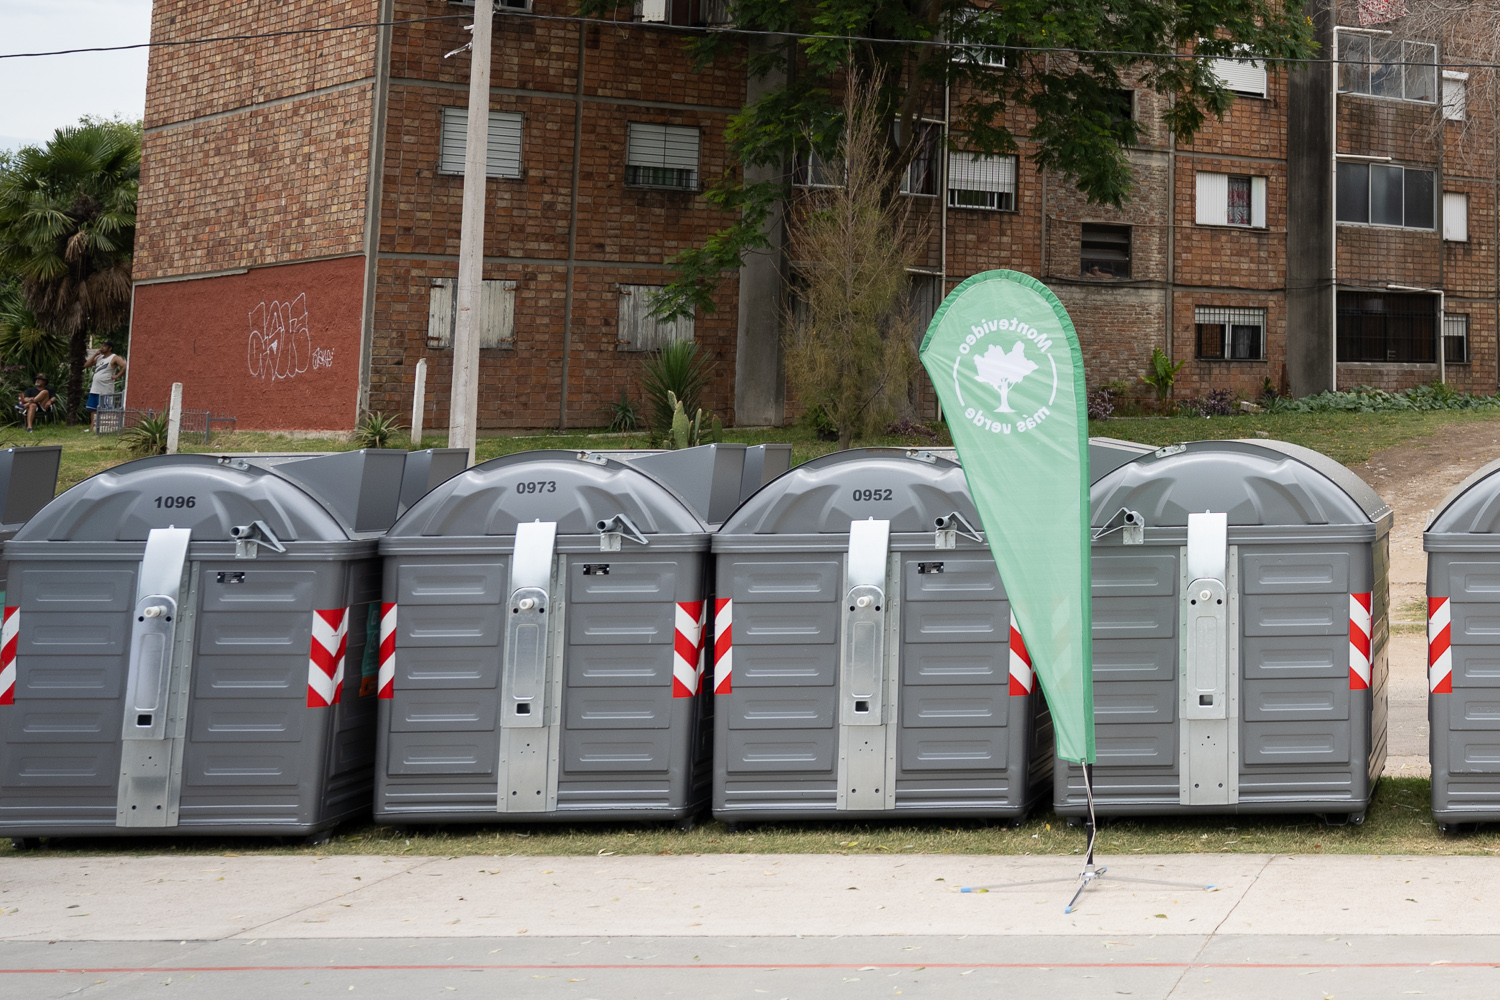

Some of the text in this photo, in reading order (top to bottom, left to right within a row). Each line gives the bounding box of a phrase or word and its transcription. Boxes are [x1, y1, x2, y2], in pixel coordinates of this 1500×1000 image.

[516, 480, 557, 495] 0973
[852, 488, 893, 502] 0952
[154, 496, 196, 509] 1096
